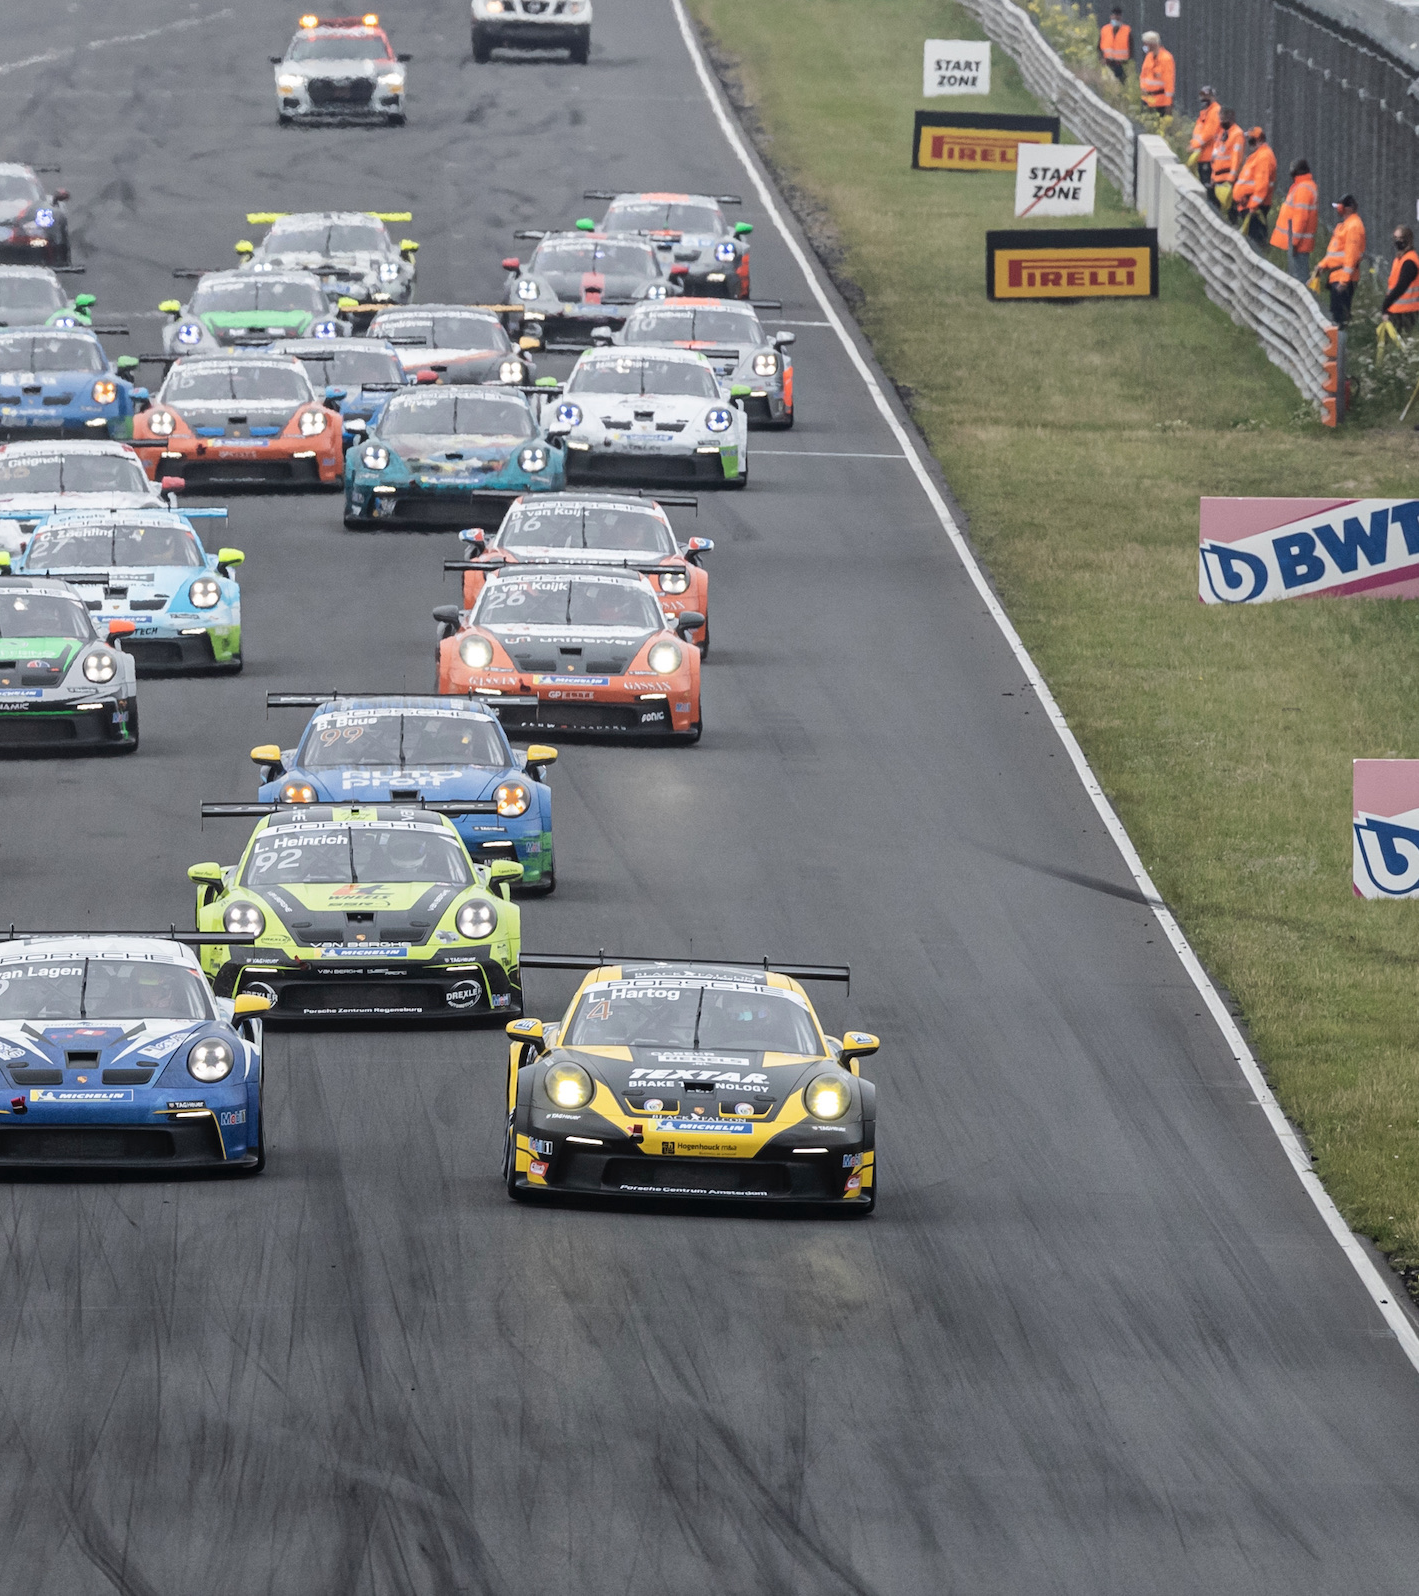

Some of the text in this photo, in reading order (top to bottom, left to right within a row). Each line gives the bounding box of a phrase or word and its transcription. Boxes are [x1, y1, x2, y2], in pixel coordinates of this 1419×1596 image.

[934, 59, 982, 73] START
[937, 74, 979, 87] ZONE
[931, 135, 1040, 163] PIREL
[1029, 167, 1087, 182] START
[1032, 185, 1081, 200] ZONE
[1008, 257, 1137, 288] PIRELLI
[526, 509, 551, 517] van
[509, 516, 542, 533] 16
[502, 583, 528, 592] van
[531, 581, 568, 592] Kuijk
[486, 590, 526, 610] 26
[539, 637, 636, 645] uniserver
[623, 681, 672, 691] GASSAN
[548, 690, 561, 698] GP
[316, 716, 378, 732] B. Buus
[320, 727, 364, 747] 99
[342, 770, 463, 779] AUTO
[276, 821, 432, 834] PORSCHE
[254, 834, 348, 854] L. Heinrich
[253, 848, 303, 873] 92
[0, 952, 175, 965] PORSCHE
[340, 948, 400, 956] MICHELIN
[27, 965, 83, 978] Lagen
[446, 986, 483, 1001] DREXLER
[607, 979, 786, 997] PORSCHE
[588, 988, 681, 1004] L. Hartog
[303, 1007, 336, 1015] Porsche
[585, 1000, 613, 1021] 4
[628, 1068, 769, 1084] TEXTAR
[628, 1080, 770, 1093] BRAKE TNOLOGY
[652, 1114, 689, 1122] BLACK
[678, 1123, 745, 1131] MICHELIN
[677, 1142, 720, 1152] Hogenhouck
[619, 1183, 768, 1196] Porsche Centrum Amsterdam
